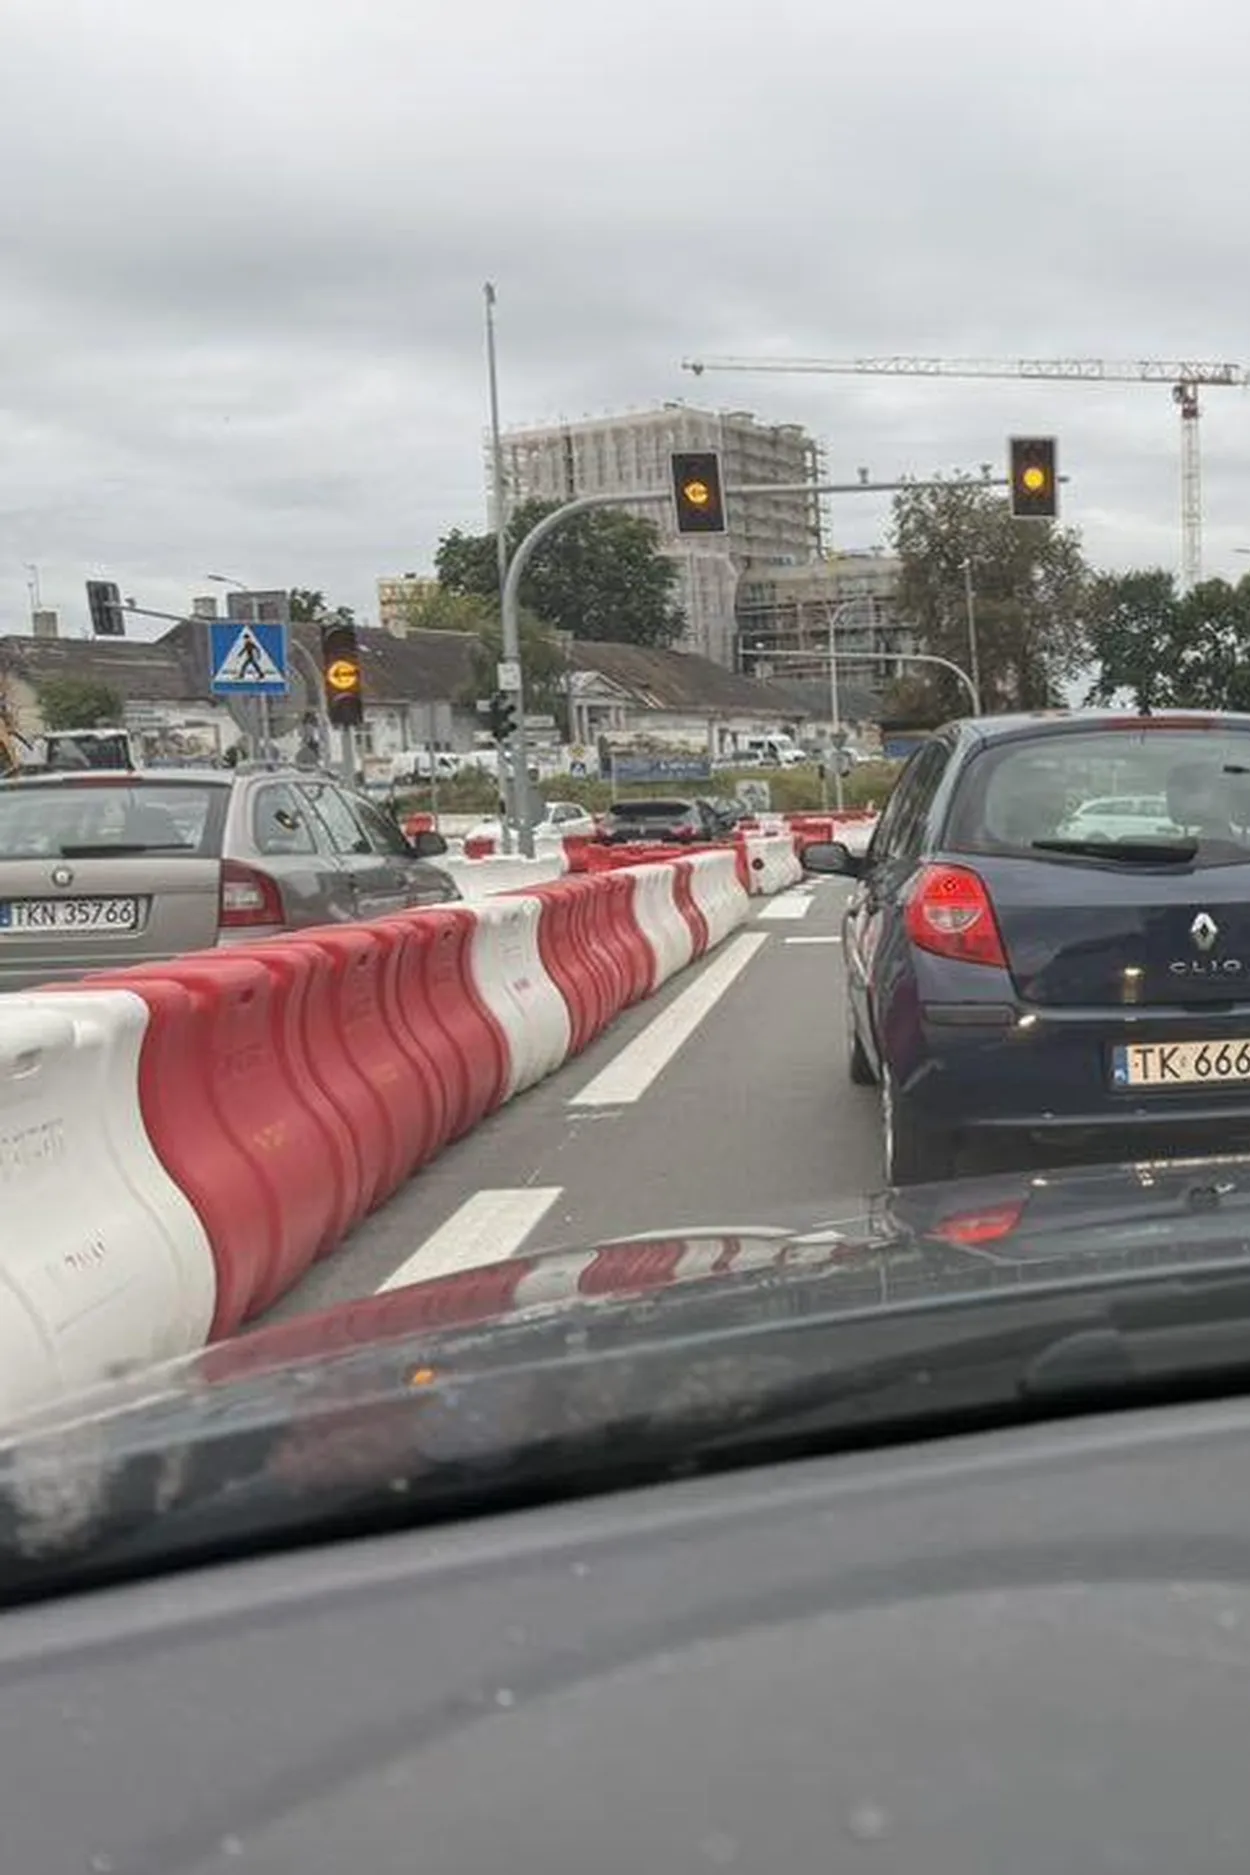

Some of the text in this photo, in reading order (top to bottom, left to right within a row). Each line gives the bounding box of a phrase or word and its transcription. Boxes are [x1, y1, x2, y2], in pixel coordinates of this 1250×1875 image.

[15, 900, 132, 926] TKN 35766
[1169, 959, 1242, 974] CLIO
[1134, 1047, 1180, 1080] TK
